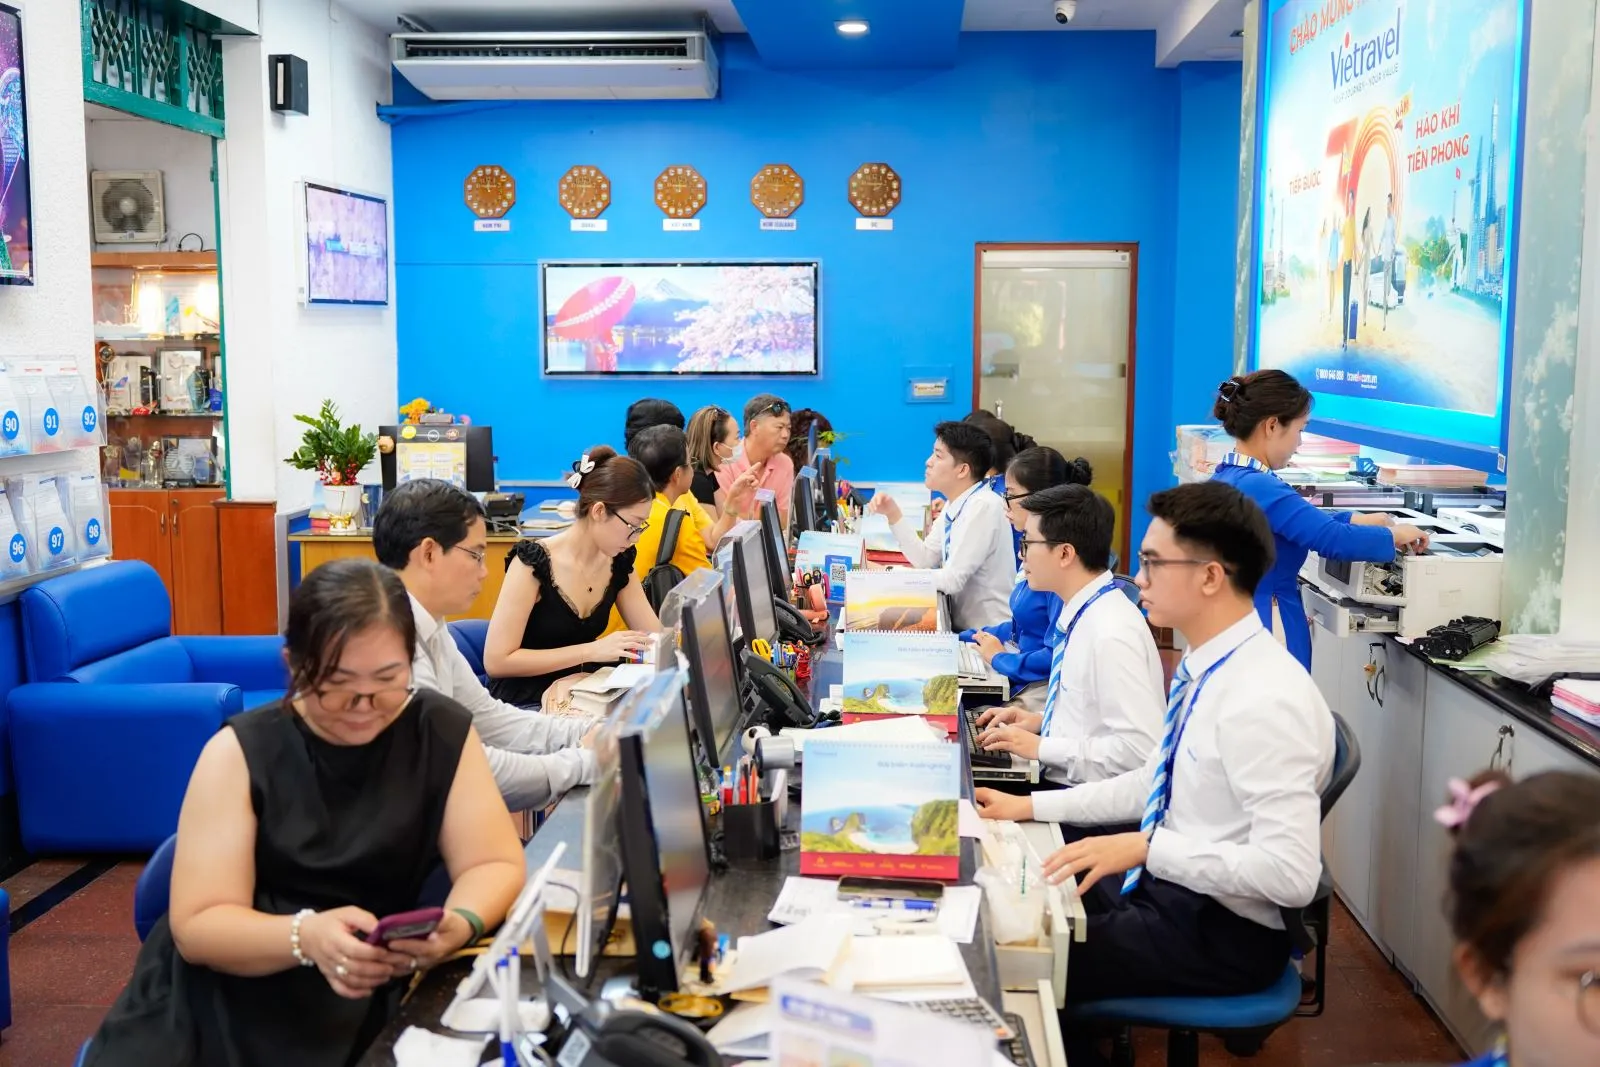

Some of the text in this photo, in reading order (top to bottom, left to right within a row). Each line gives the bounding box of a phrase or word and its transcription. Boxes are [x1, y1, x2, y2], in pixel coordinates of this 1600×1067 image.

[1290, 11, 1318, 54] CHÀO
[1331, 7, 1400, 90] Vietravel
[1407, 134, 1469, 173] TIÊN PHONG
[5, 417, 17, 432] 90
[46, 414, 57, 429] 91
[84, 411, 95, 426] 92
[88, 524, 99, 539] 98
[12, 541, 24, 555] 96
[51, 533, 62, 548] 97
